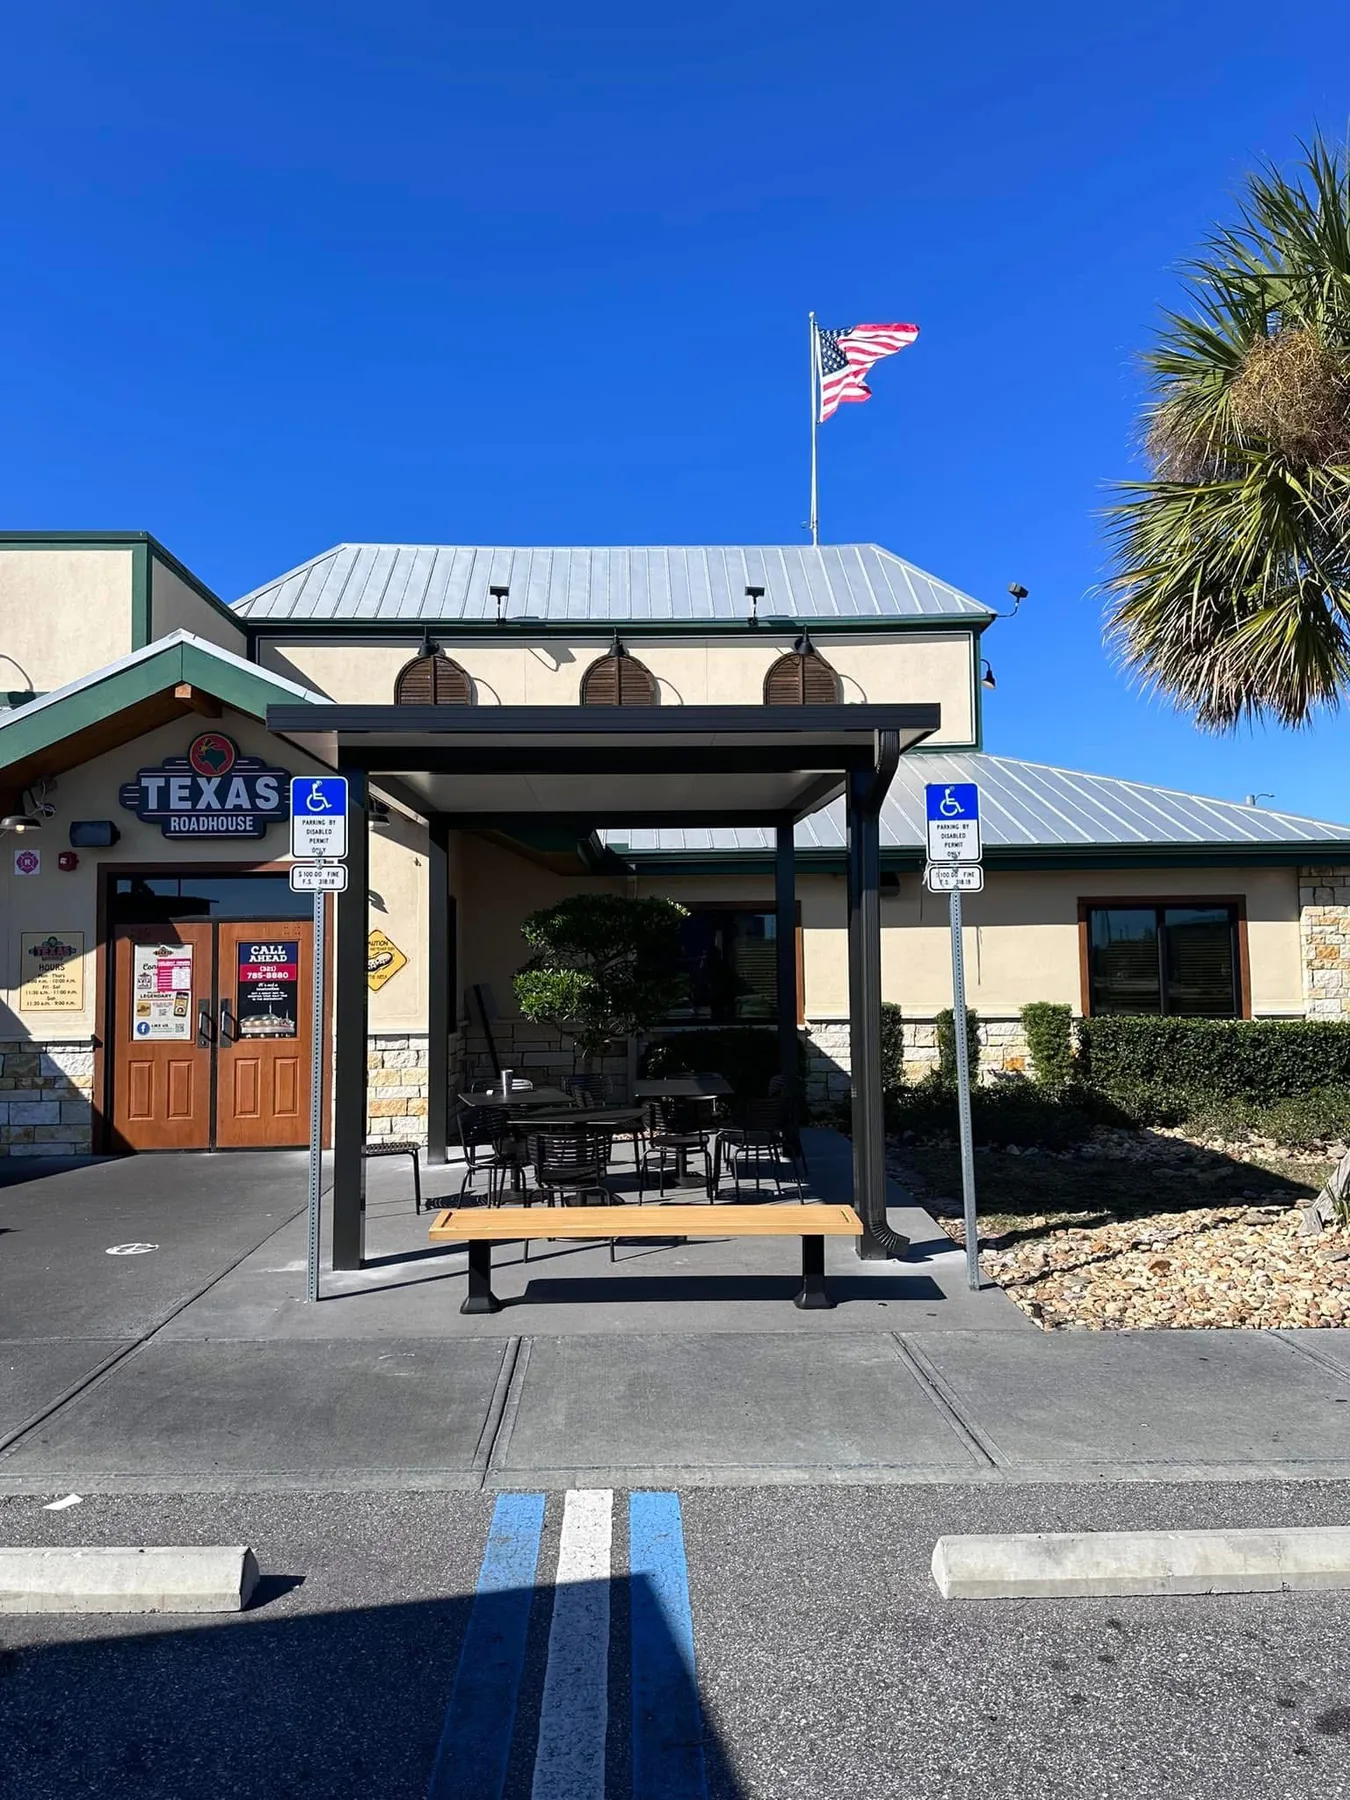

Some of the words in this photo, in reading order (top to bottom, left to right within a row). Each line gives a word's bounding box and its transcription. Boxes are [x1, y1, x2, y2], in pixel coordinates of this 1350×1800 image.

[141, 776, 279, 810] TEXAS
[171, 816, 253, 831] ROADHOUSE
[250, 946, 286, 954] CALL
